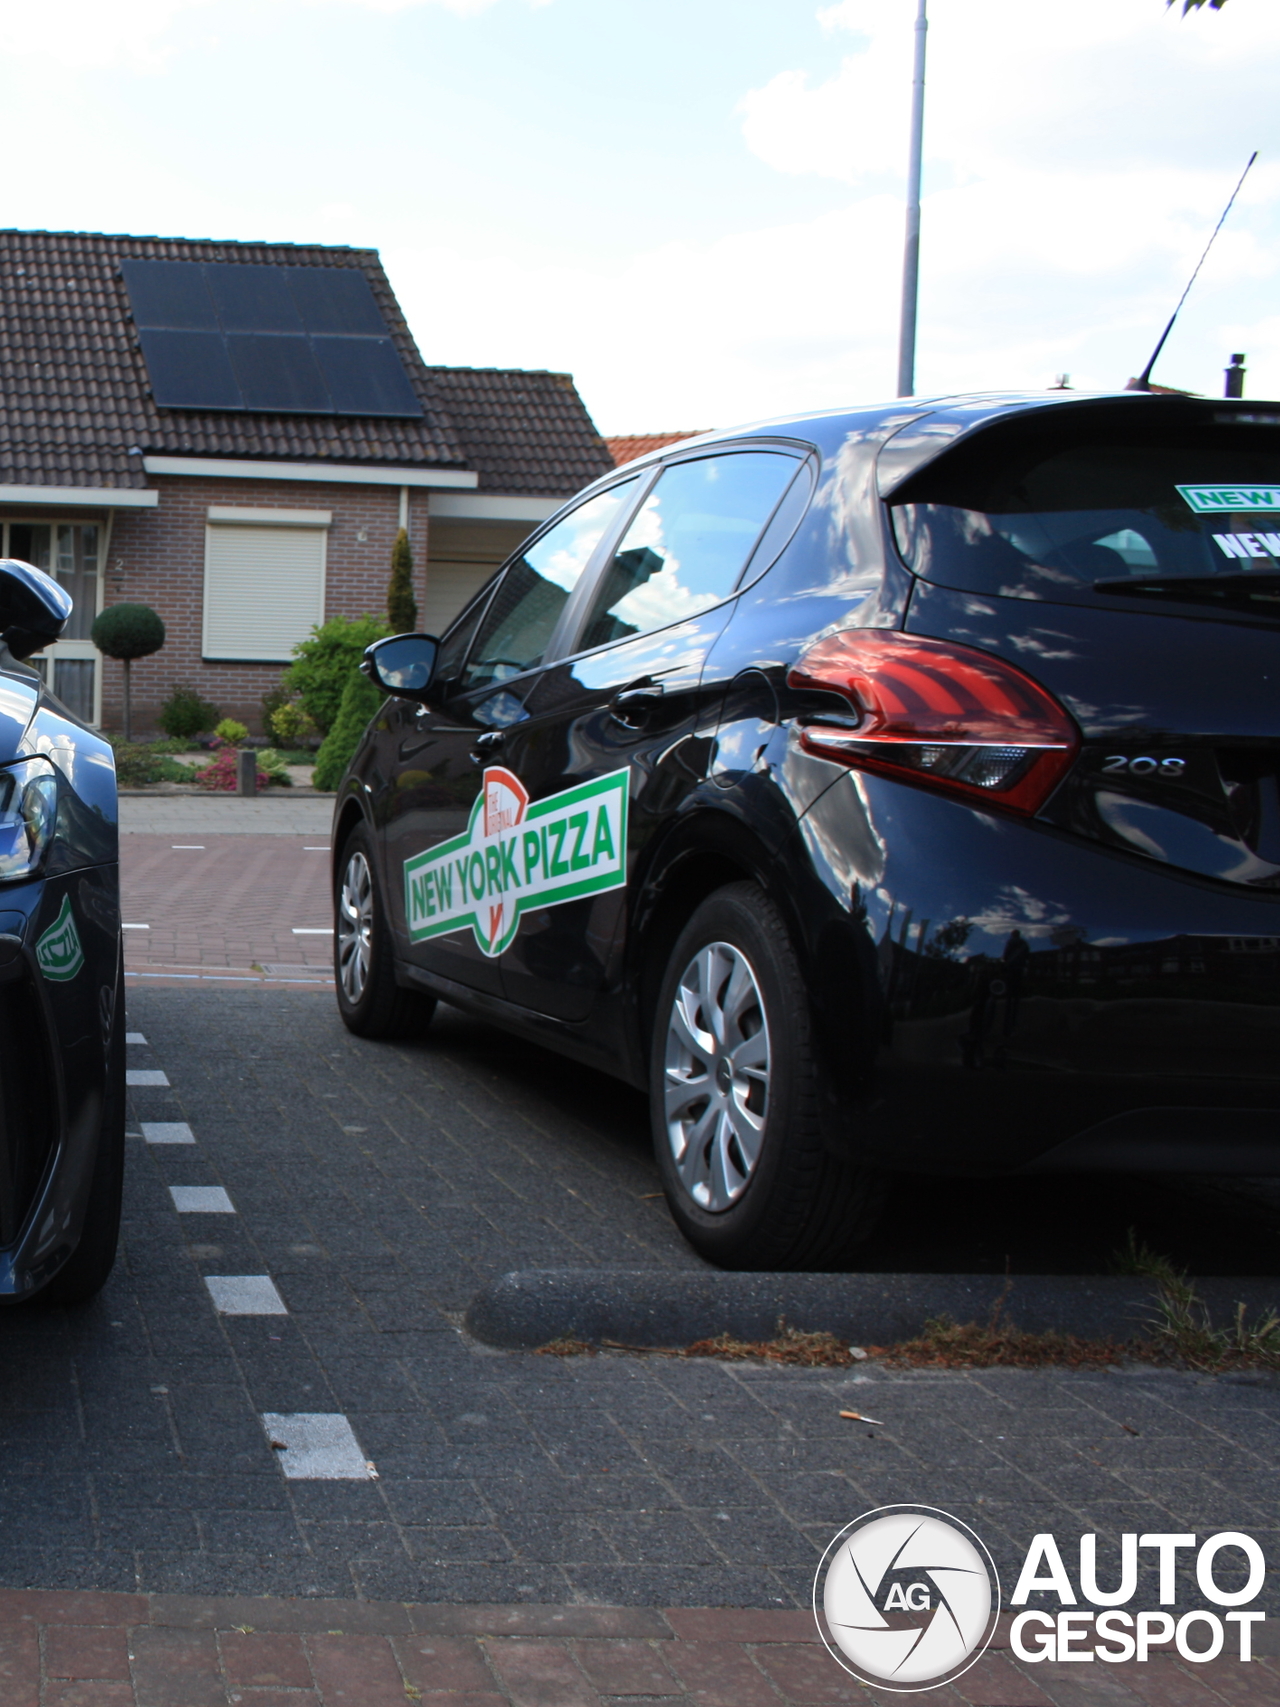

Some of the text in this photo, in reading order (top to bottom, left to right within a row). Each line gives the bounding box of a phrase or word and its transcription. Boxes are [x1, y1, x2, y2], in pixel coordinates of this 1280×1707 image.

[1193, 491, 1273, 505] NEW
[1211, 533, 1280, 558] NEW
[115, 559, 123, 571] 2
[1102, 755, 1185, 776] 208
[412, 804, 615, 922] NEW YORK PIZZA
